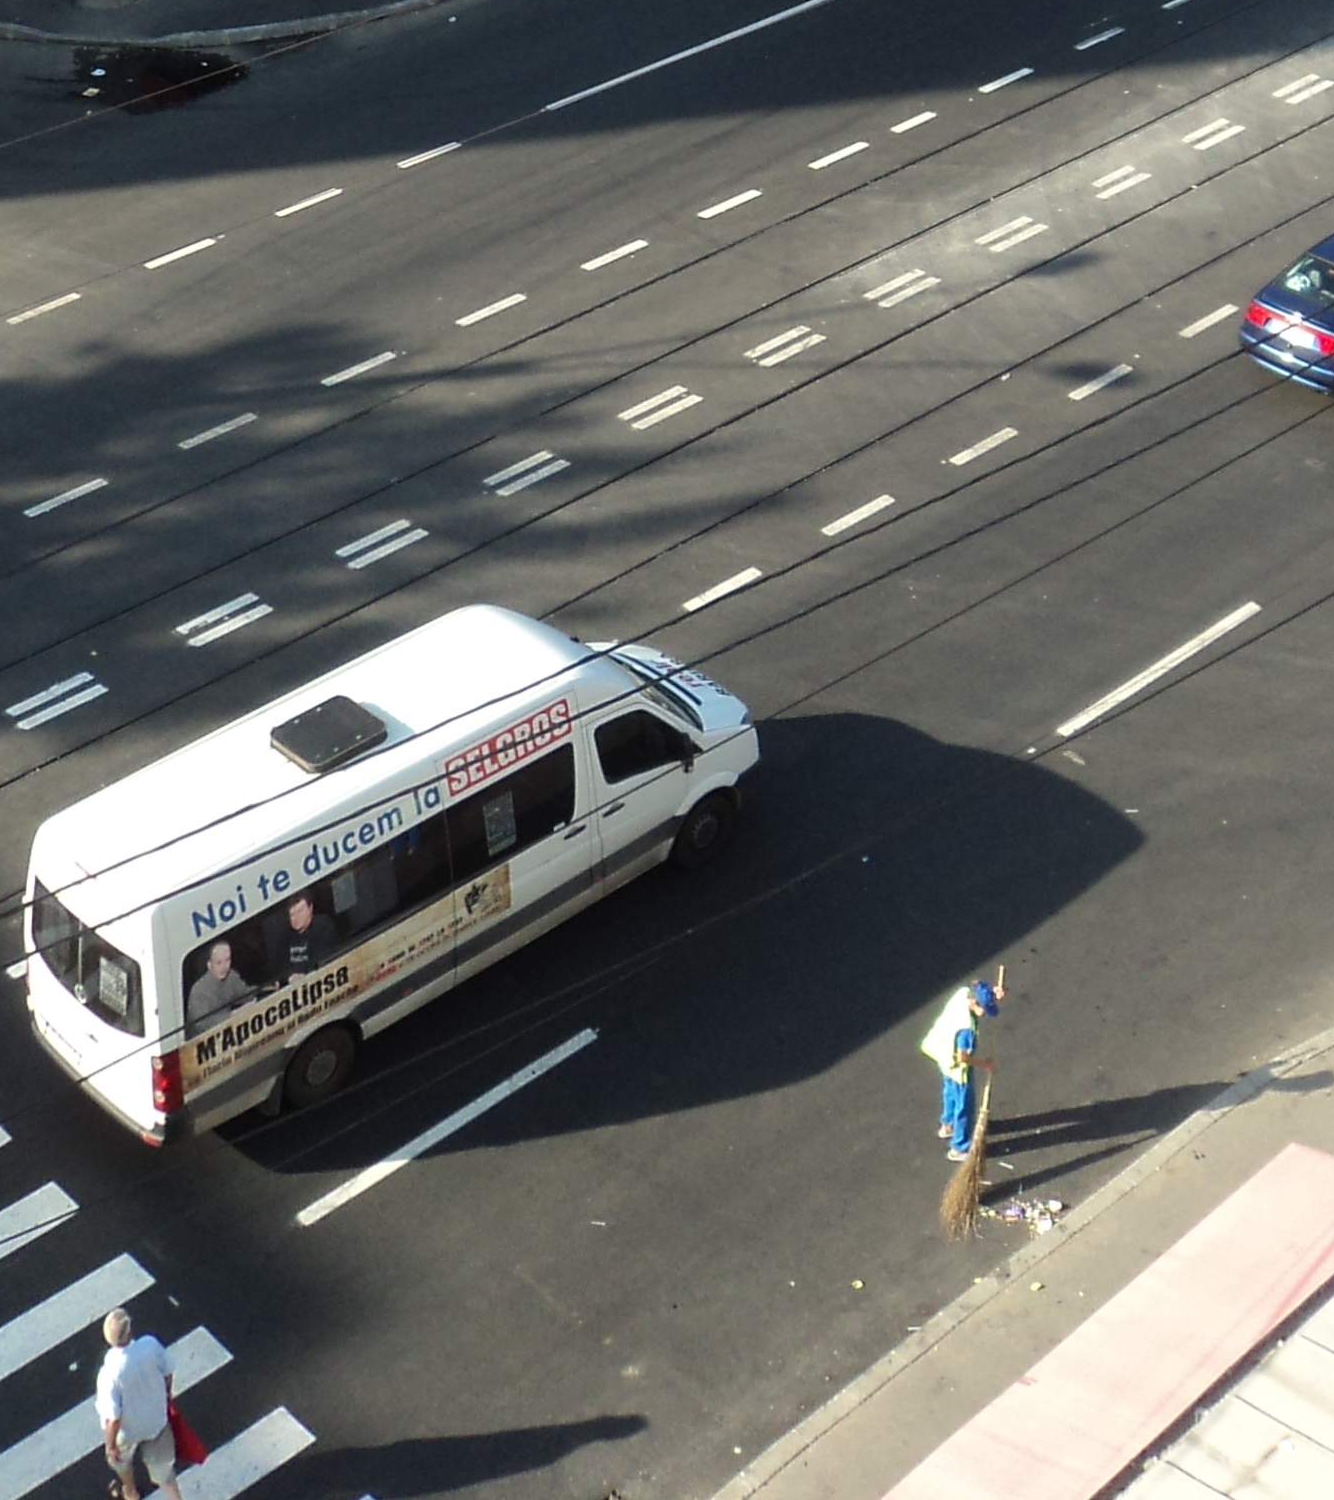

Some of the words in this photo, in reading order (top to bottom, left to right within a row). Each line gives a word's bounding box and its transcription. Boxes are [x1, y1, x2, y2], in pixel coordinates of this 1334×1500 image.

[192, 885, 247, 938] Noi
[258, 869, 291, 901] te
[303, 807, 404, 876] ducem
[412, 785, 441, 816] la
[447, 703, 570, 792] SELGROS
